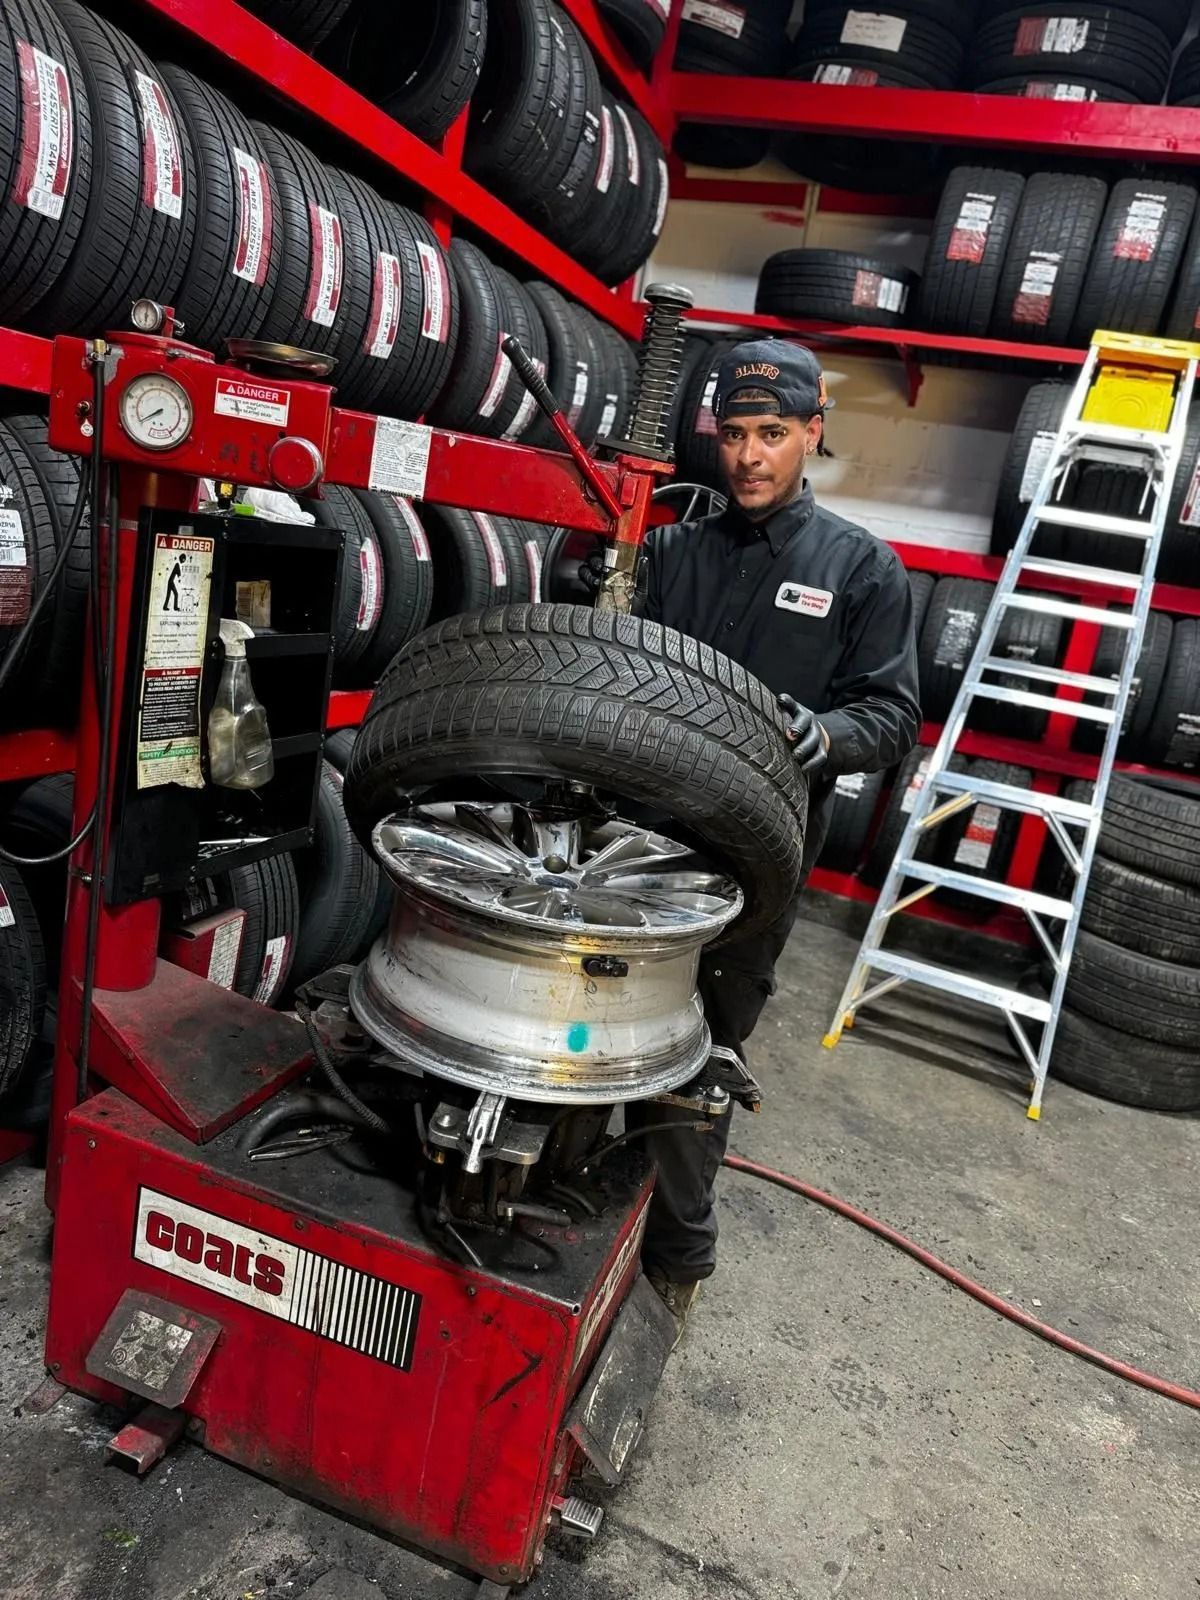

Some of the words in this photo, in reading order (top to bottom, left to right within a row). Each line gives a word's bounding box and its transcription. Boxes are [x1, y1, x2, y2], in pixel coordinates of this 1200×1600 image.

[45, 62, 59, 137] 225/45ZR17
[48, 143, 58, 169] 94W
[162, 148, 172, 170] 94W
[43, 171, 53, 186] XL
[164, 173, 173, 187] XL
[249, 175, 255, 187] XL
[244, 217, 257, 274] 225/45ZR17
[237, 386, 279, 401] DANGER
[171, 538, 212, 552] DANGER
[146, 1210, 286, 1296] coats
